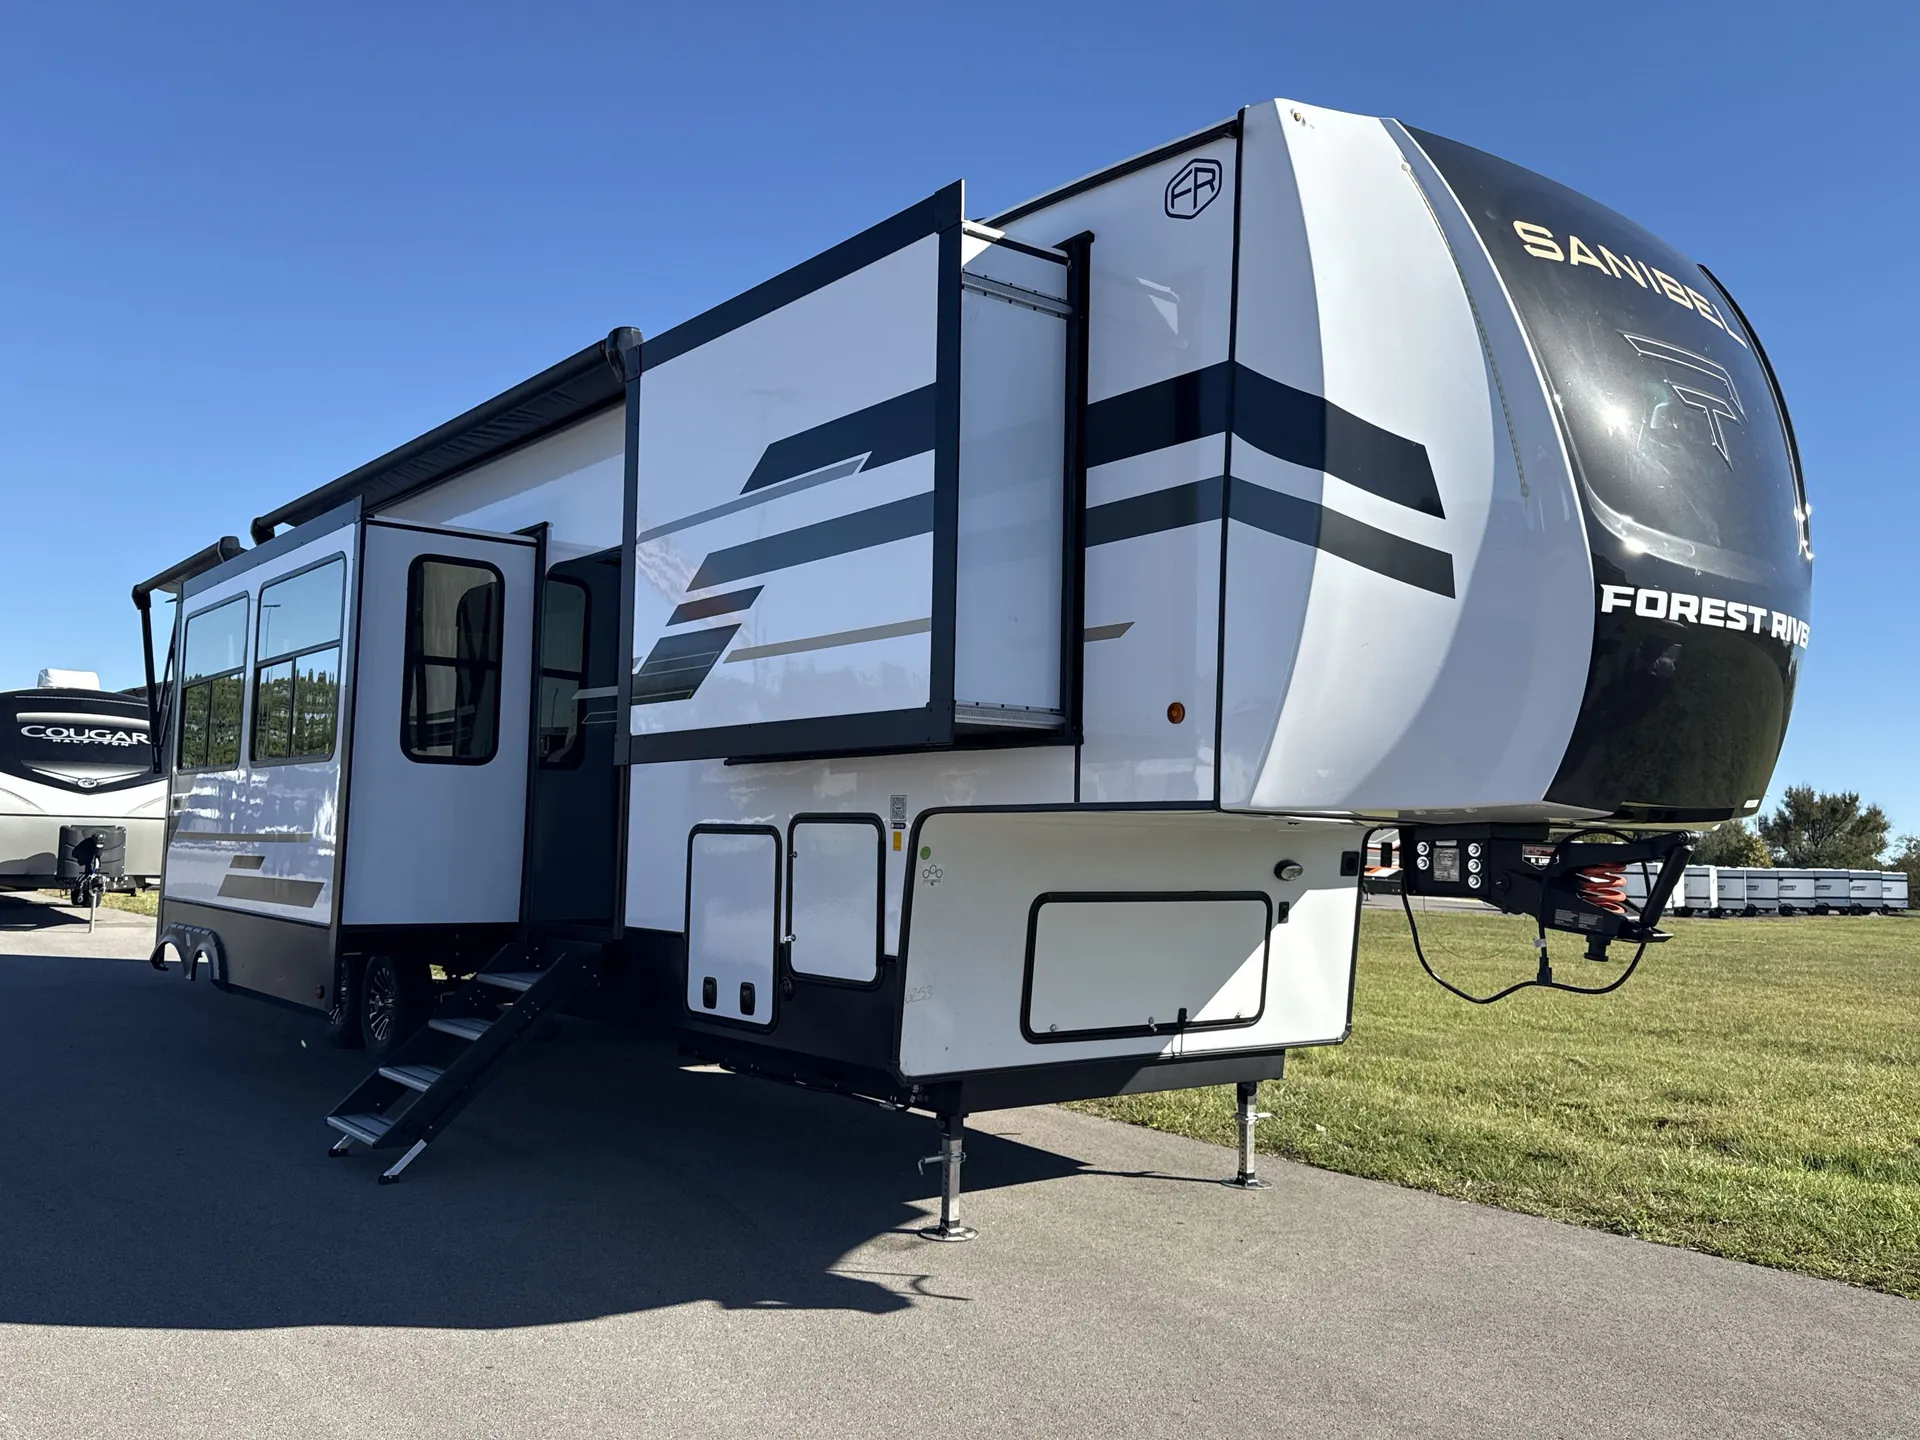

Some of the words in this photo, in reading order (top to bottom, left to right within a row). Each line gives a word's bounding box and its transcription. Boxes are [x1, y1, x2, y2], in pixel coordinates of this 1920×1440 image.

[1512, 219, 1748, 349] SANIBEL
[1600, 583, 1768, 634] FOREST
[1770, 610, 1811, 650] RIVE
[20, 725, 151, 744] COUGAR
